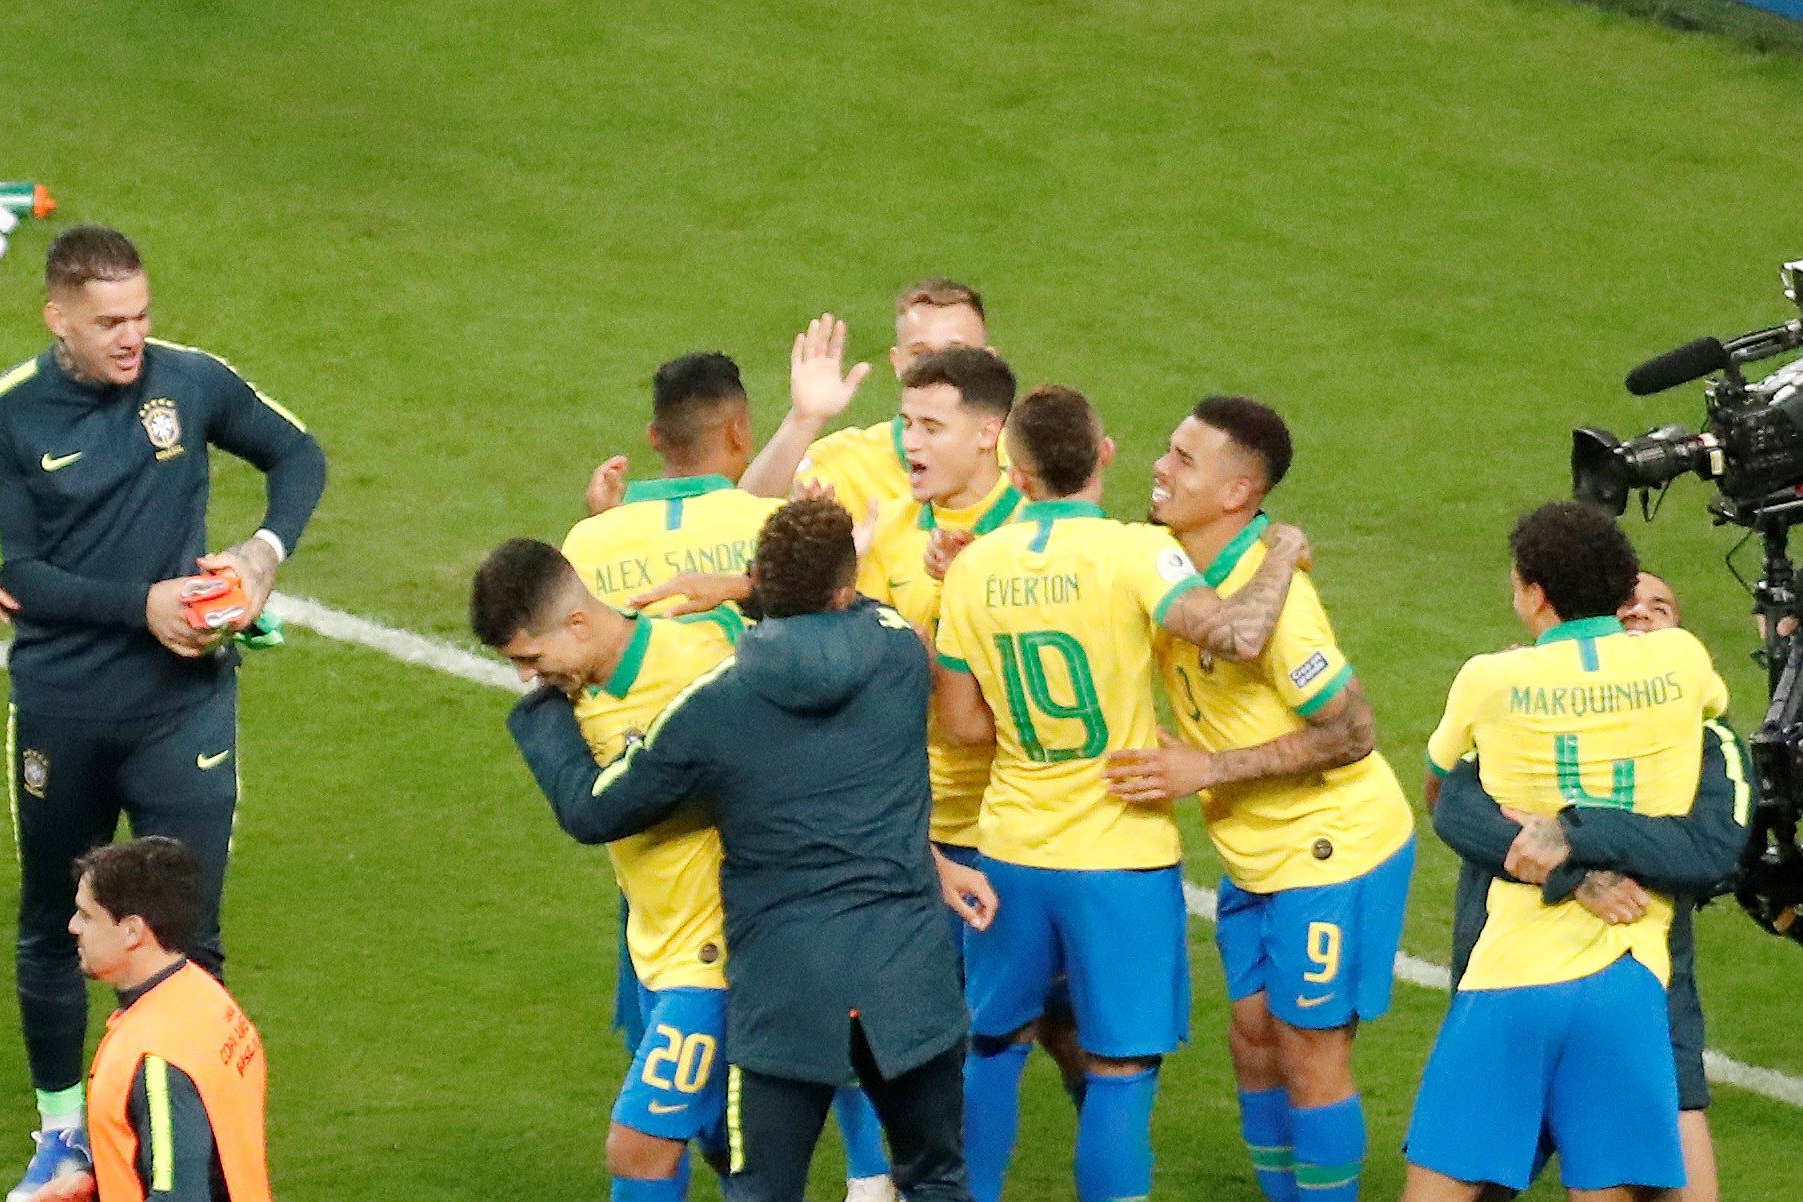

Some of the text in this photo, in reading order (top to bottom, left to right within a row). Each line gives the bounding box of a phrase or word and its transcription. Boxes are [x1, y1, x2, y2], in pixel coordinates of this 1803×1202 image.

[596, 556, 653, 594] ALEX
[985, 572, 1081, 609] ÉVERTON
[993, 629, 1110, 763] 19
[1510, 670, 1684, 717] MARQUINHOS
[1554, 733, 1635, 814] 4
[1303, 920, 1343, 984] 9
[641, 1023, 717, 1094] 20
